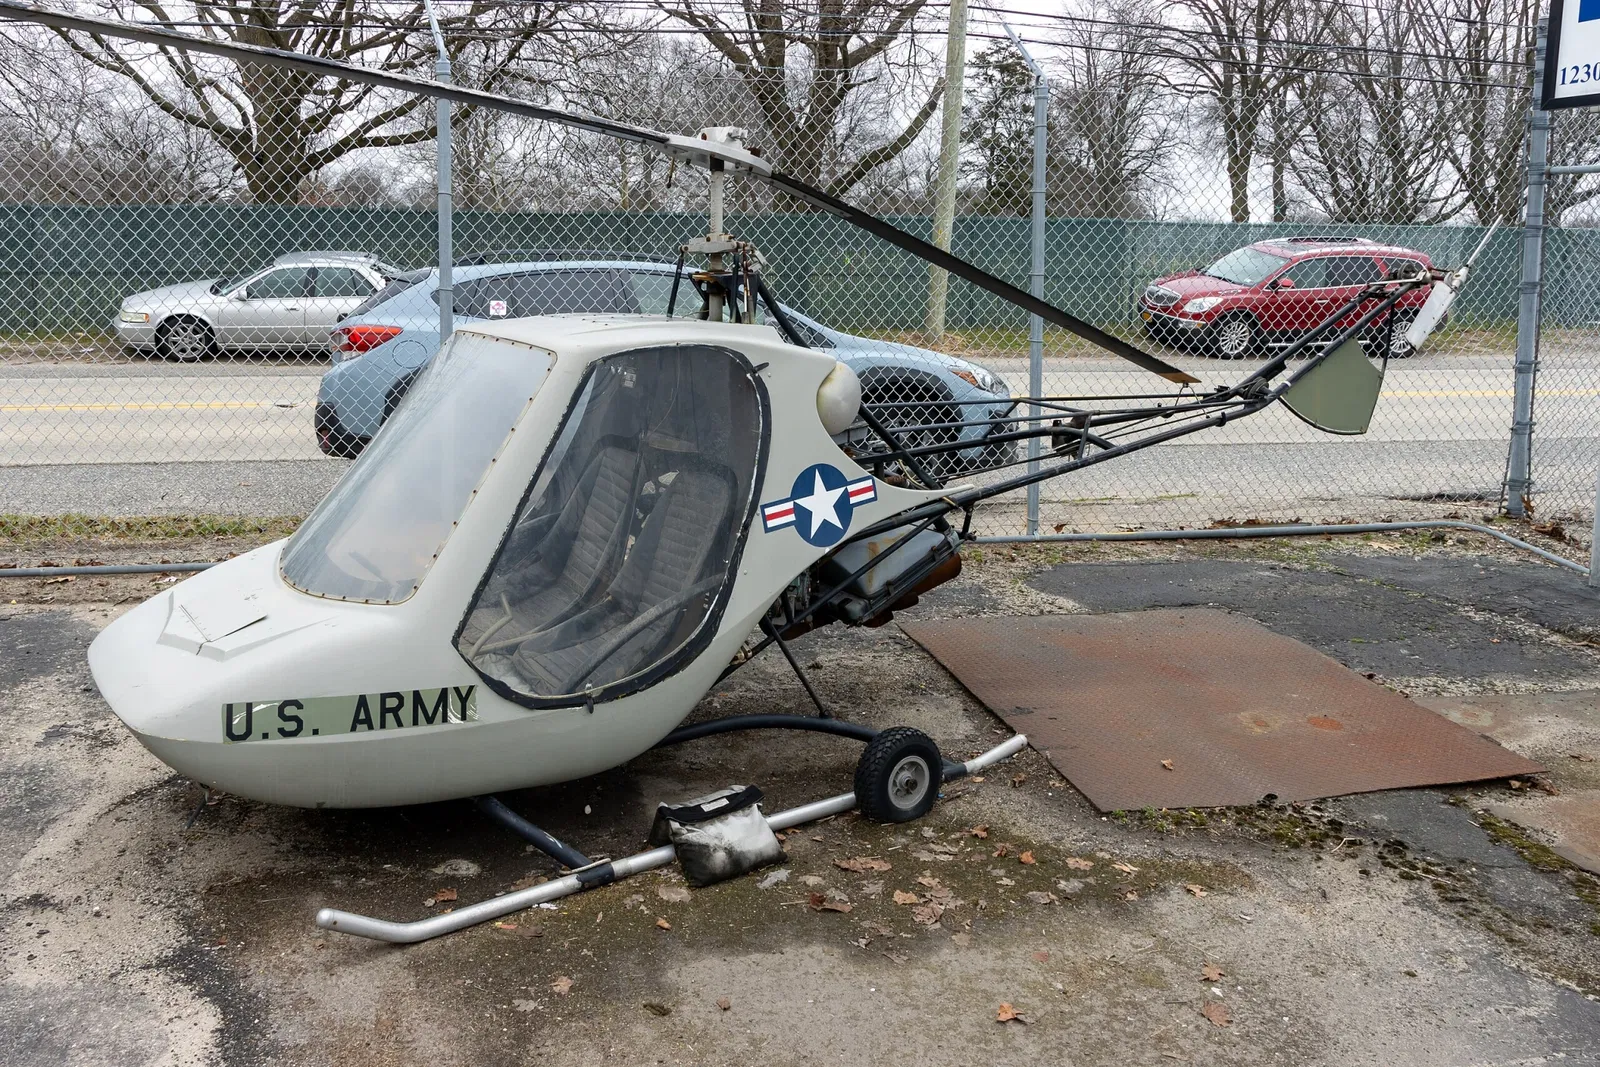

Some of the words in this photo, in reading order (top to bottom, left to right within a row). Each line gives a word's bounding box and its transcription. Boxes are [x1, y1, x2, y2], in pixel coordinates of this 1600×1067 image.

[1559, 61, 1600, 86] 1230
[225, 699, 319, 742] U.S.
[349, 684, 476, 733] ARMY
